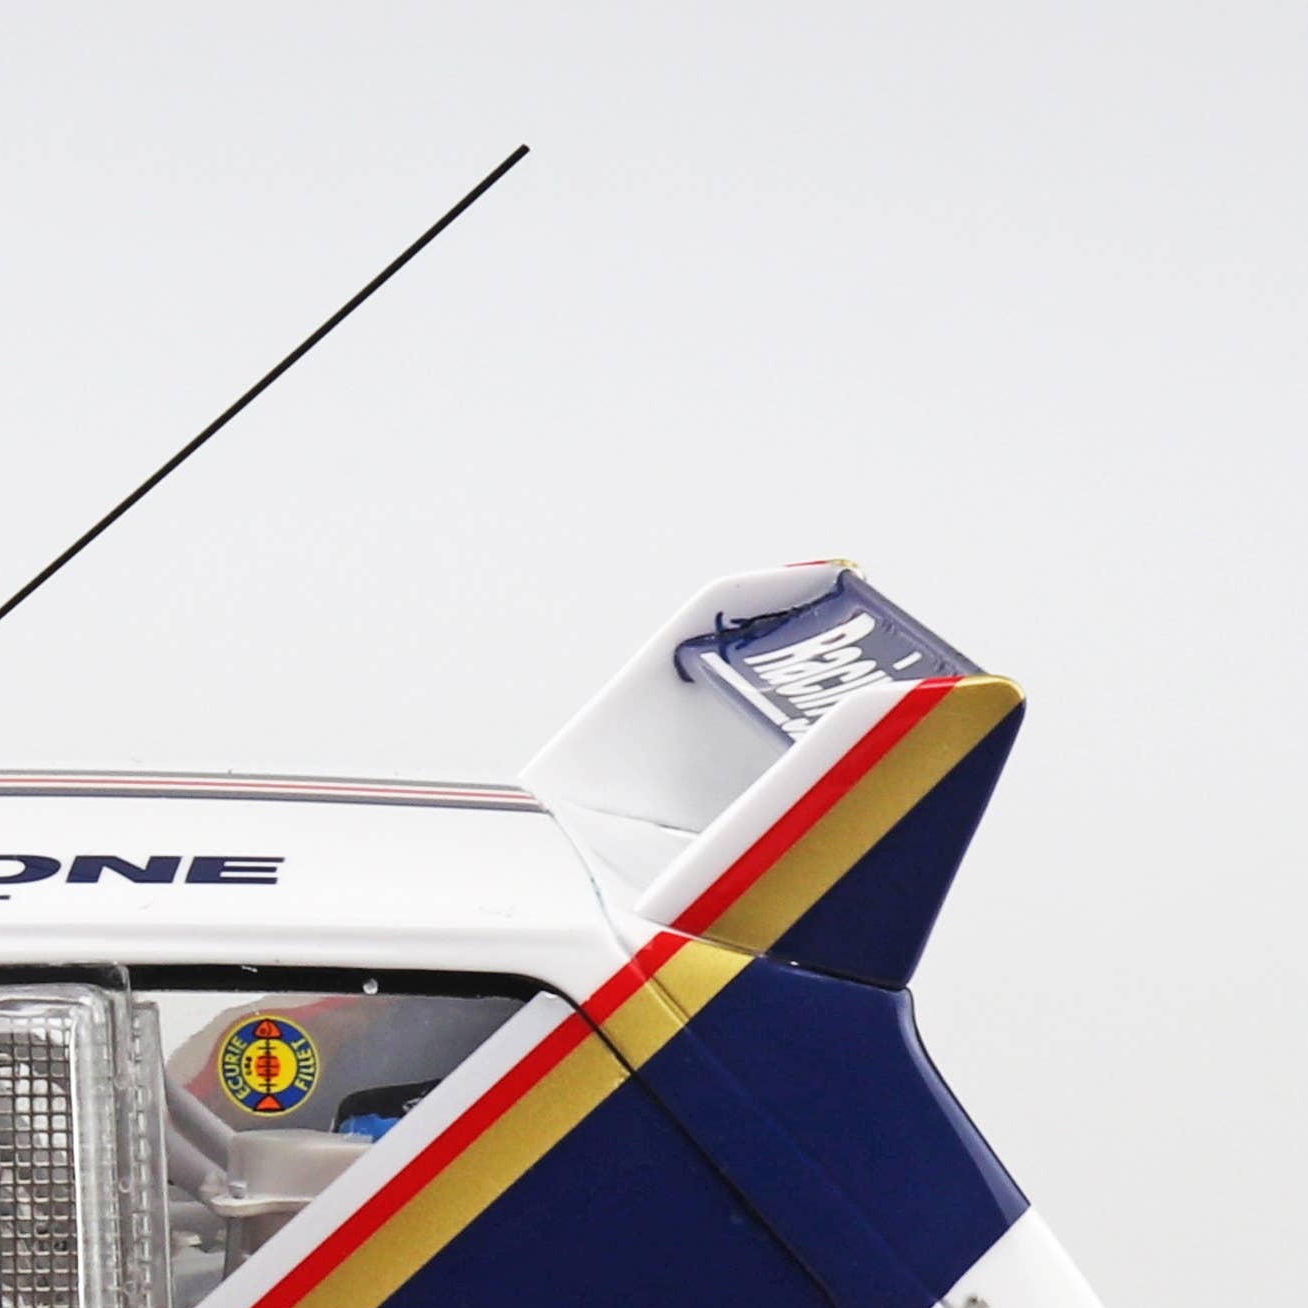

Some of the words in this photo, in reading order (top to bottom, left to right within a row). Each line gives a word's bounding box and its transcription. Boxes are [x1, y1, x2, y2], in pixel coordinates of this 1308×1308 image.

[743, 612, 922, 734] Racin
[223, 1035, 252, 1100] ECURIE
[290, 1038, 316, 1091] FILLET
